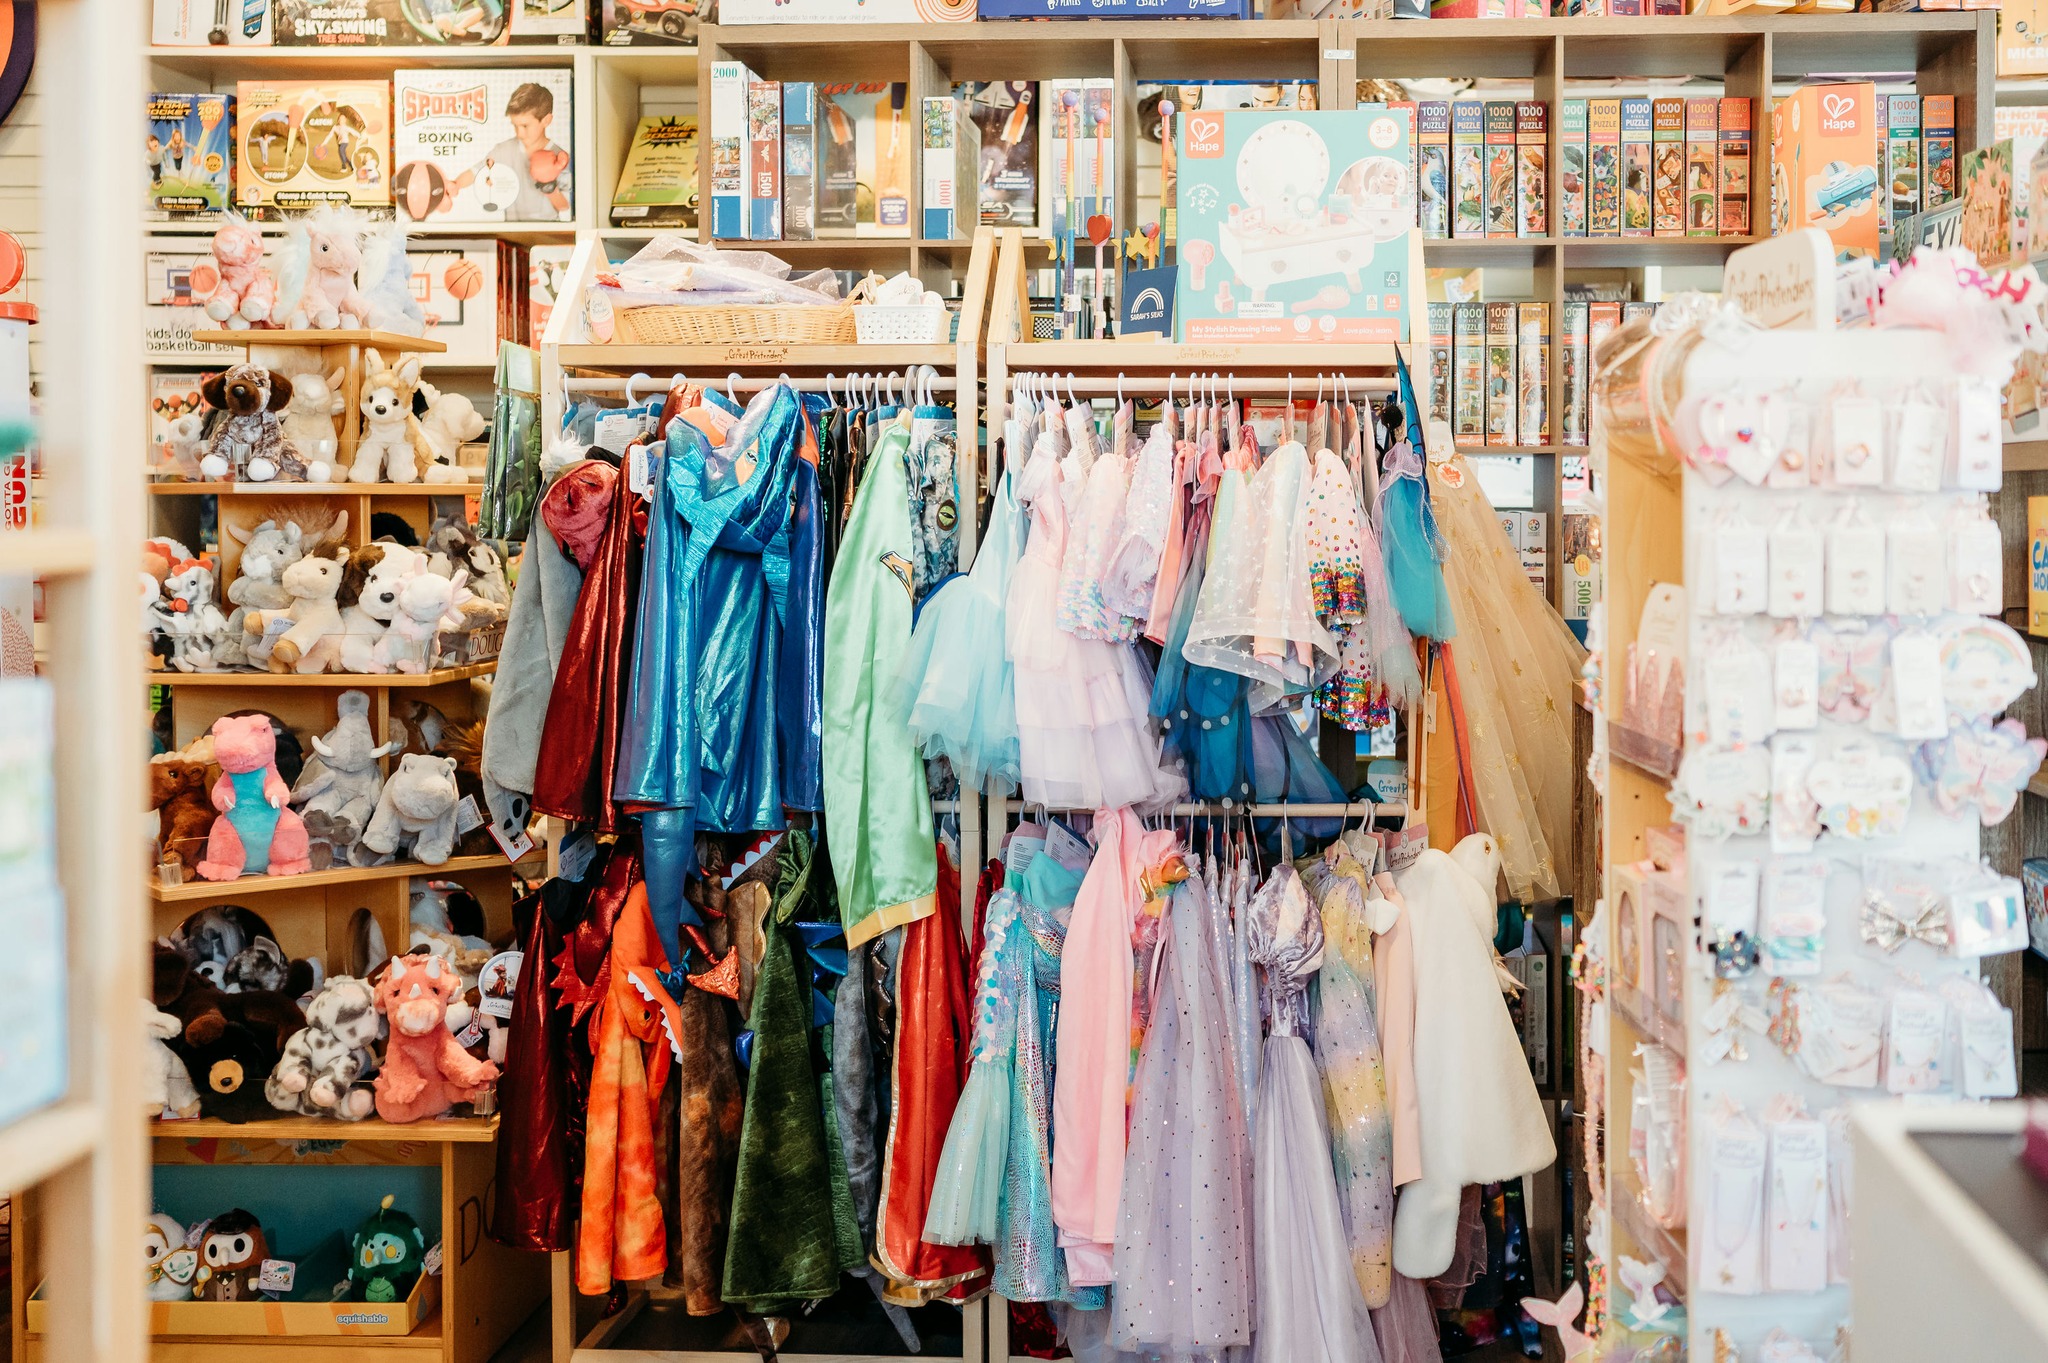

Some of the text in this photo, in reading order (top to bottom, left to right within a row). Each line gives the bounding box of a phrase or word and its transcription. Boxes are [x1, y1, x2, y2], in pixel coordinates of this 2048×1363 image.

[310, 6, 367, 19] slackers
[295, 18, 387, 36] SKY SWING
[317, 34, 365, 43] TREE SWING
[2007, 46, 2048, 60] MICR
[713, 67, 738, 79] 2000
[405, 86, 485, 122] SPORTS
[1625, 104, 1650, 114] 1000
[1656, 103, 1681, 113] 1000
[1690, 104, 1714, 113] 1000
[1724, 104, 1748, 112] 1000
[1893, 101, 1917, 110] 1000
[1927, 101, 1952, 110] 1000
[198, 106, 221, 117] 200
[1421, 106, 1446, 116] 1000
[1456, 106, 1480, 117] 1000
[1489, 106, 1513, 117] 1000
[1518, 106, 1543, 117] 1000
[1563, 105, 1583, 115] 000
[1593, 105, 1617, 115] 1000
[309, 118, 333, 126] CATCH
[1422, 121, 1446, 129] PUZZLE
[1563, 120, 1583, 128] UZZLE
[1823, 119, 1856, 132] Hape
[418, 132, 473, 143] BOXING
[433, 145, 458, 156] SET
[1190, 142, 1220, 153] Hape
[264, 171, 288, 179] STOMP
[760, 171, 772, 197] 1500
[939, 179, 951, 206] 1000
[795, 205, 806, 228] 1000
[1130, 311, 1164, 321] SARAH'S SILKS
[1430, 308, 1451, 318] 000
[1458, 308, 1482, 318] 1000
[1491, 308, 1515, 318] 1000
[1523, 308, 1547, 318] 1000
[1192, 325, 1281, 334] My Stylish Dressing Table
[1430, 323, 1450, 331] UZZLE
[145, 328, 171, 339] kids
[146, 340, 211, 351] basketball
[729, 348, 783, 359] Great Pretenders
[1180, 348, 1235, 360] Great Pretenders
[12, 444, 27, 531] GUN
[1577, 580, 1592, 605] 500
[1378, 779, 1401, 793] Great
[1389, 852, 1402, 868] Great
[336, 1313, 389, 1325] squishable
